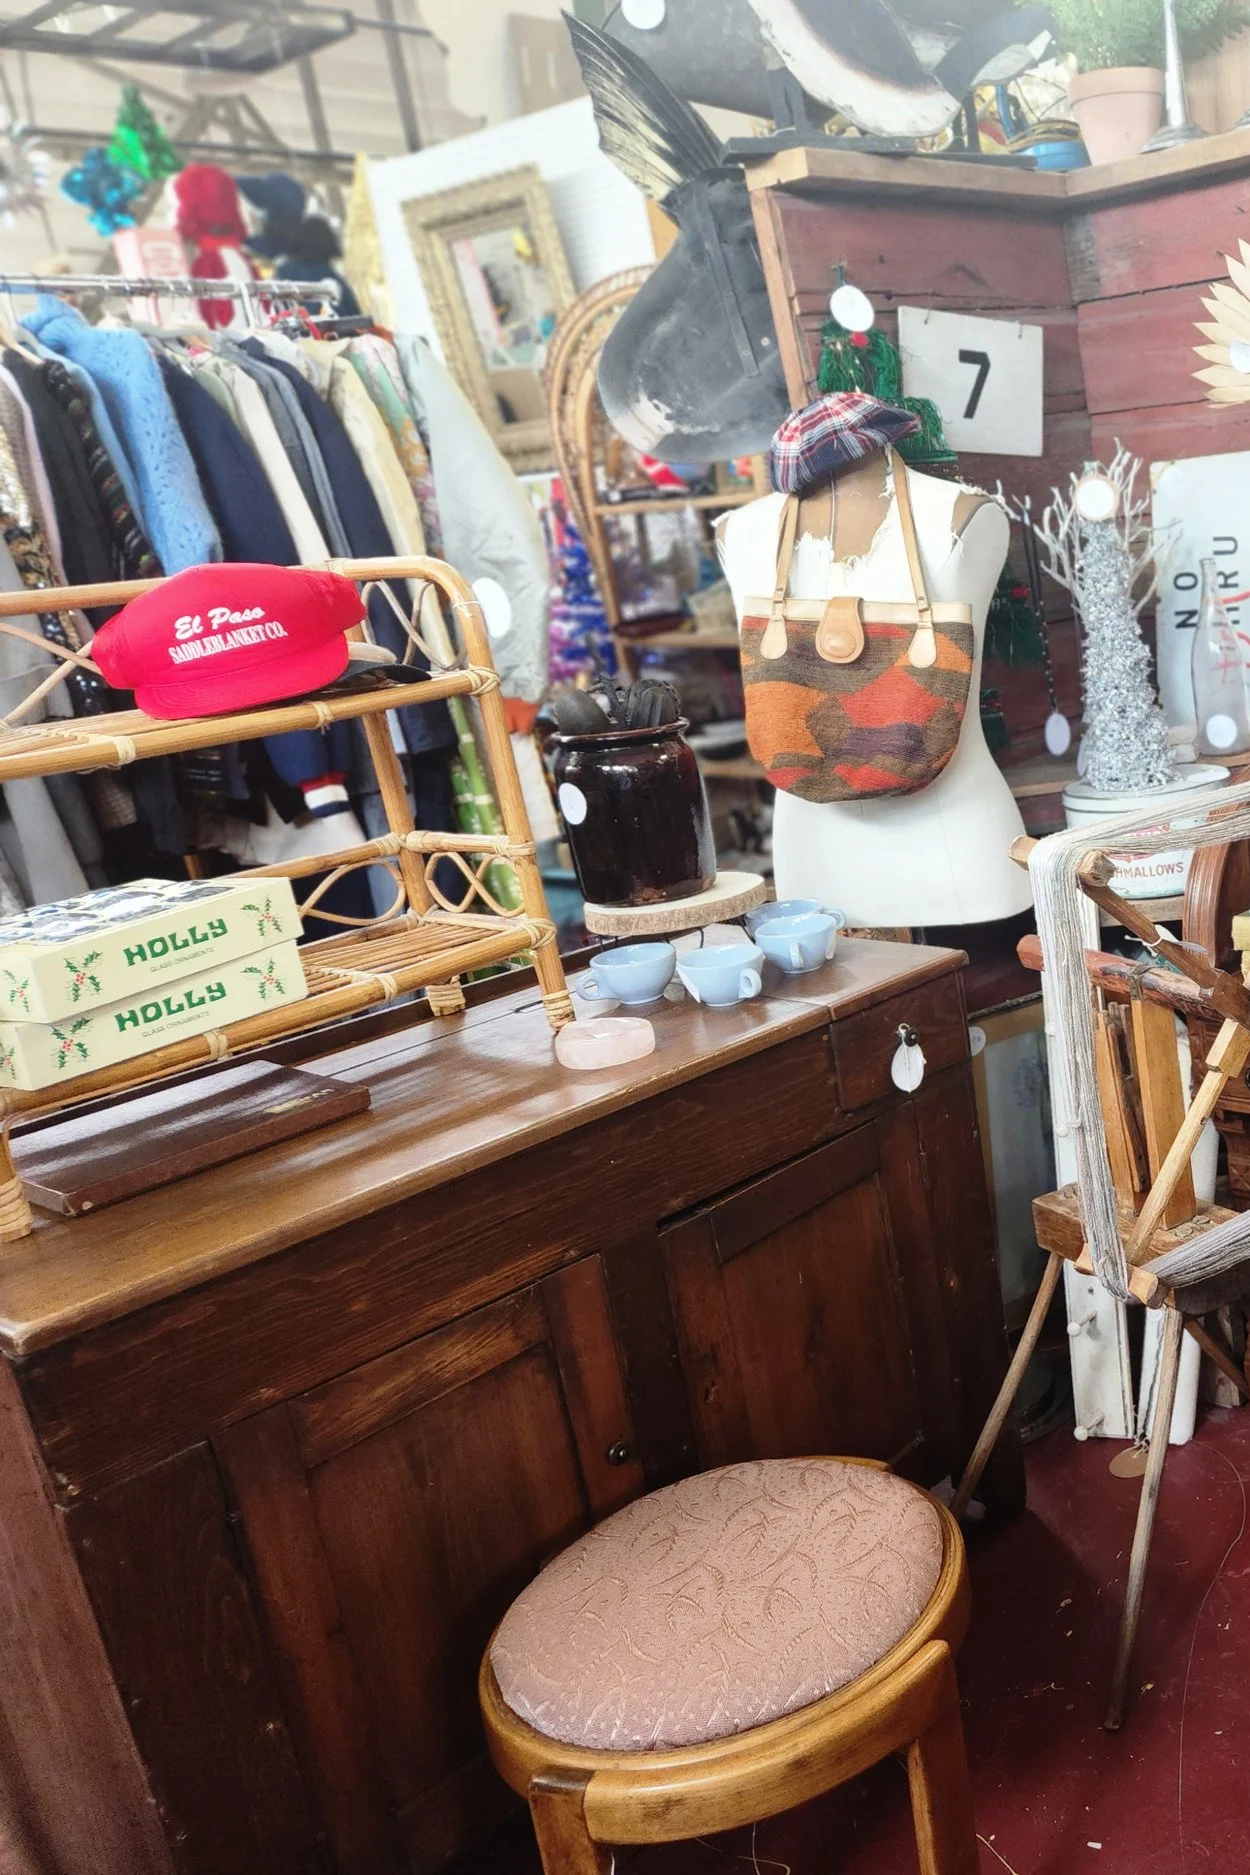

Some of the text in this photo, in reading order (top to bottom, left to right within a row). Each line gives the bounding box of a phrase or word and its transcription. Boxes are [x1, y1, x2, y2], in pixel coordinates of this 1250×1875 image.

[958, 349, 991, 420] 7
[1173, 571, 1199, 630] NO
[174, 606, 265, 640] El Paso
[168, 624, 267, 664] SADDLEBLANKET
[1115, 861, 1184, 878] HMALLOWS
[123, 918, 229, 967] HOLLY
[150, 947, 215, 972] GLASS ORNAMENTS
[114, 981, 227, 1032] HOLLY
[141, 1010, 210, 1038] GLASS ORNAMENTS
